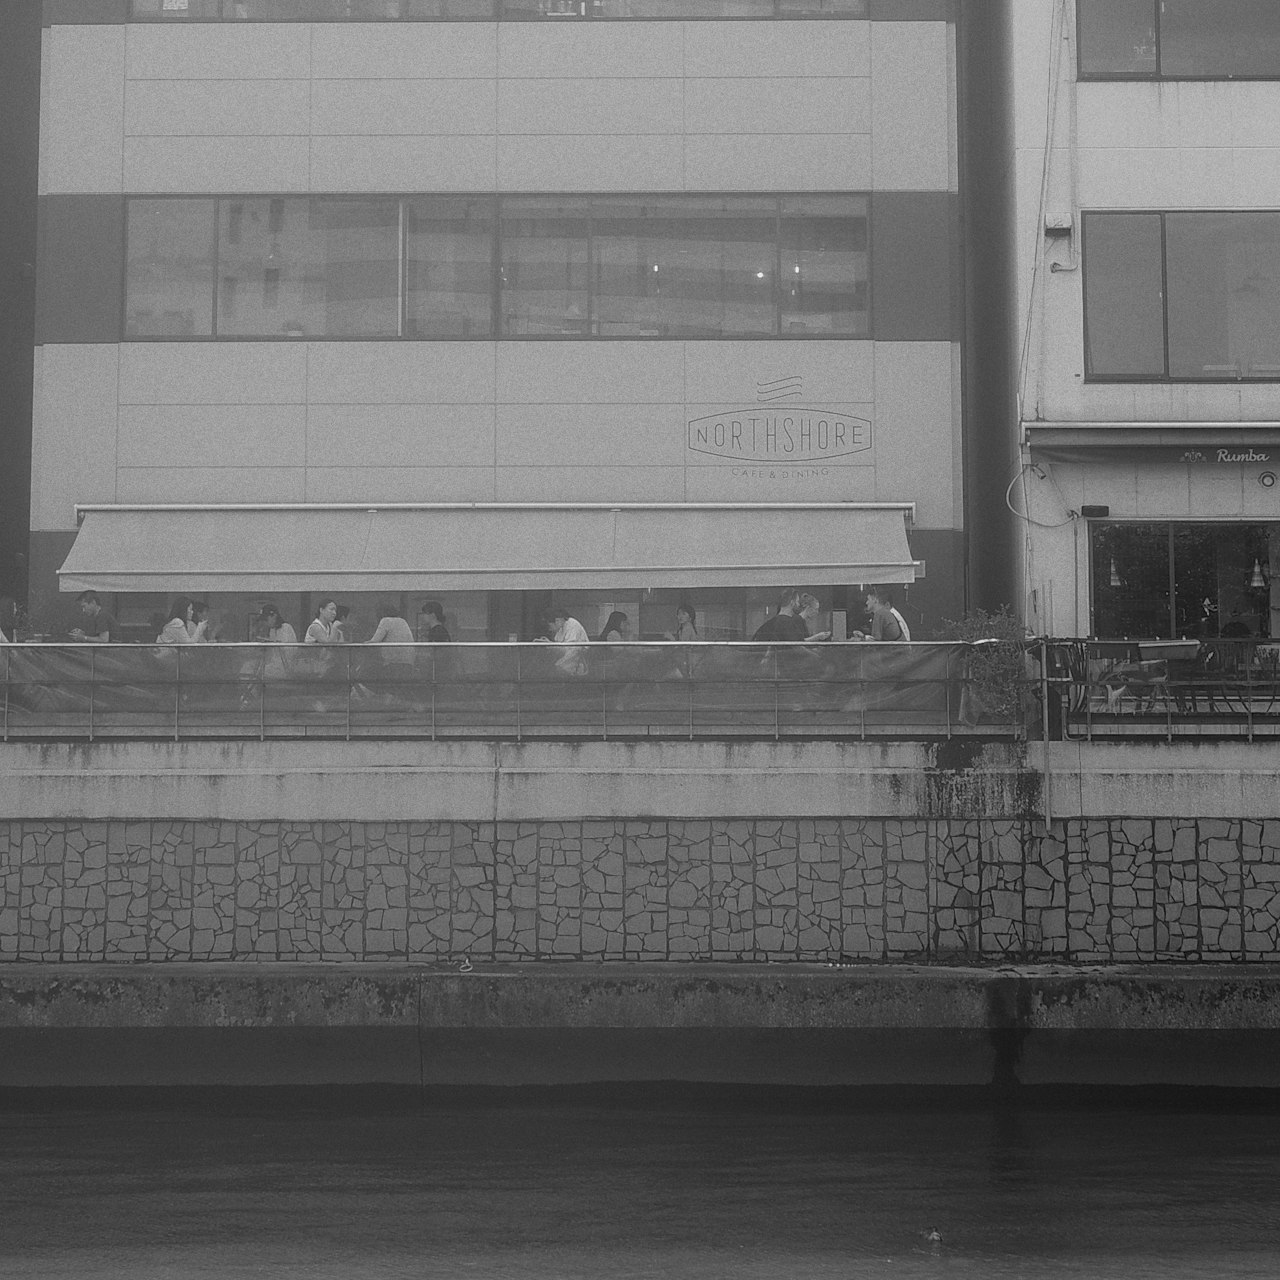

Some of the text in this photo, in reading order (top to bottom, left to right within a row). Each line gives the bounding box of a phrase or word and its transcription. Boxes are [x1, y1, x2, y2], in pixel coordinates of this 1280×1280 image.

[696, 417, 863, 453] NORTHSHORE
[1216, 448, 1270, 463] Rumba
[782, 467, 829, 479] DINING
